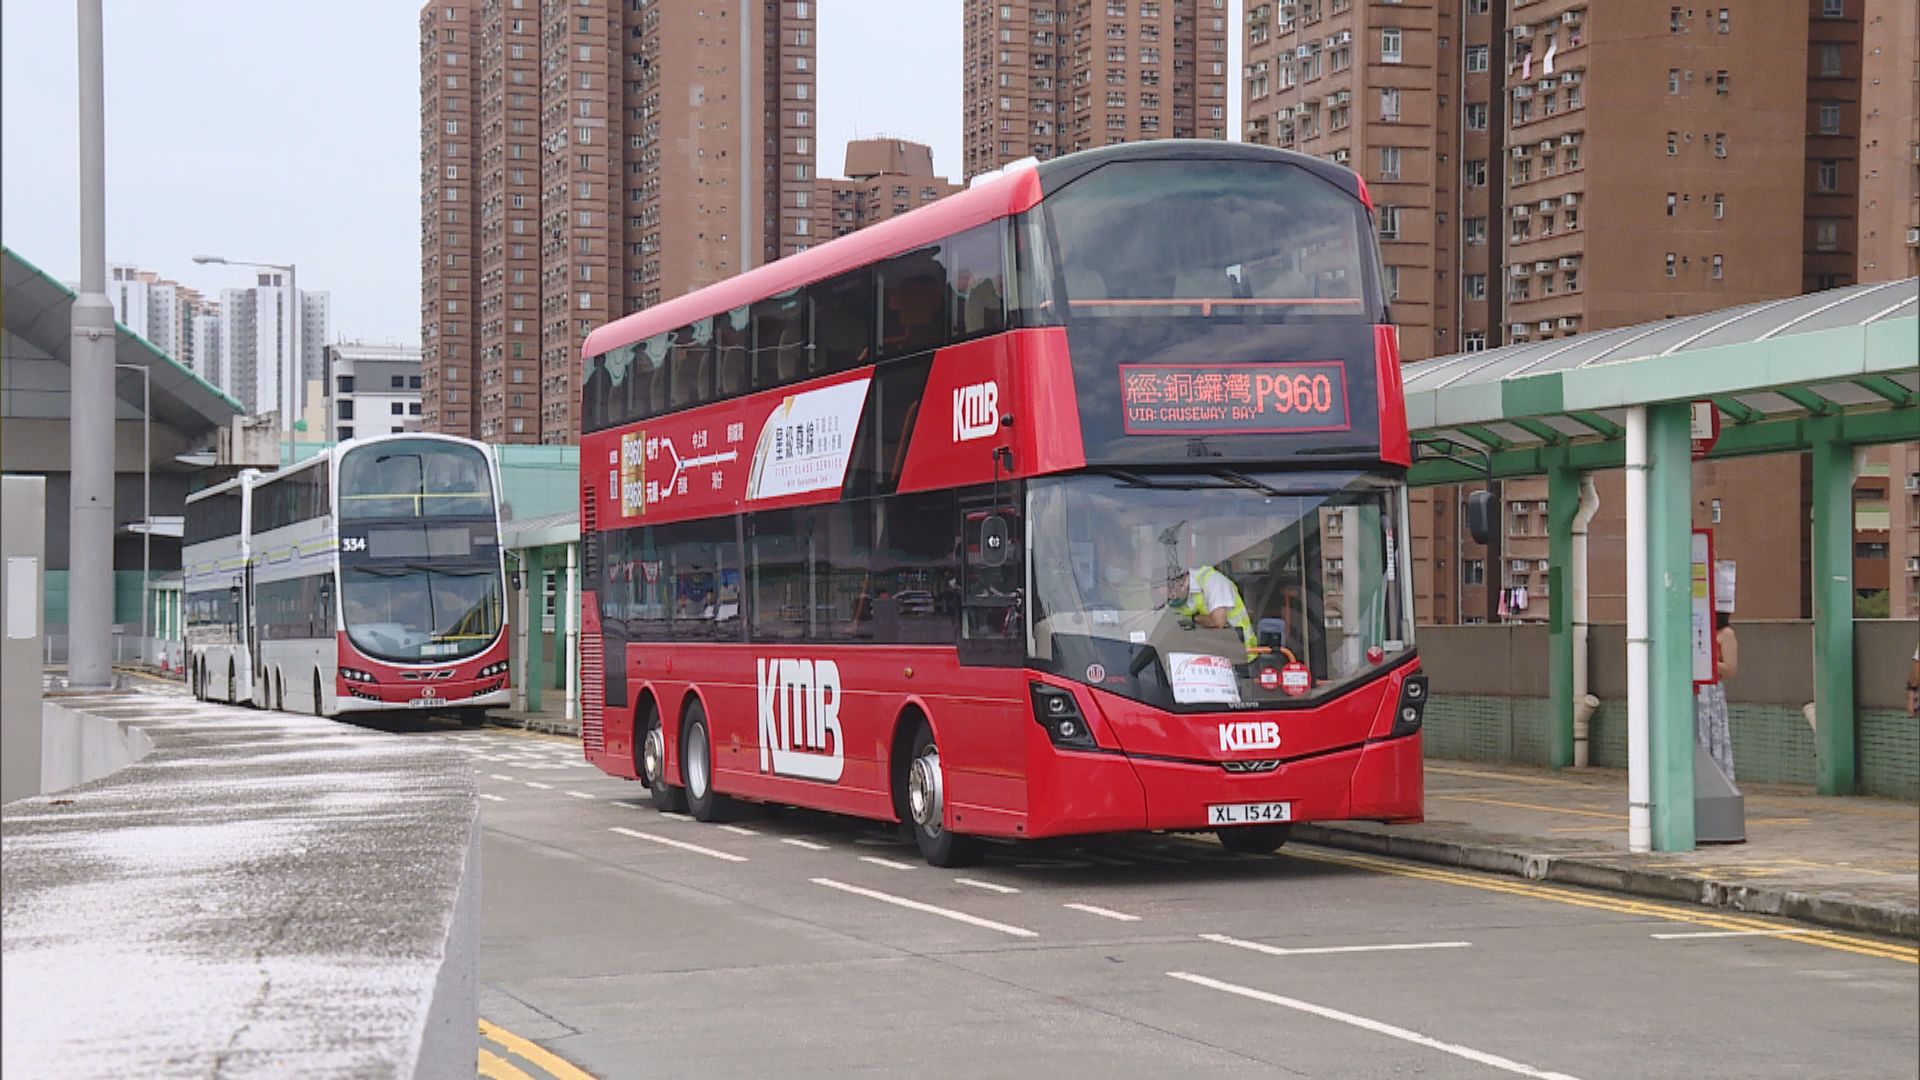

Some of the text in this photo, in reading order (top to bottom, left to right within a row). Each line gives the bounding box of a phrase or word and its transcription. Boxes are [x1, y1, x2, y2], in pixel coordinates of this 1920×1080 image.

[1256, 374, 1331, 413] P960
[952, 381, 999, 442] KMB
[1160, 407, 1227, 421] CAUSEWAY
[1231, 406, 1257, 421] BAY
[342, 537, 367, 552] 334
[757, 658, 845, 782] KMB
[1218, 722, 1281, 751] KMB
[1216, 803, 1283, 822] XL 1542
